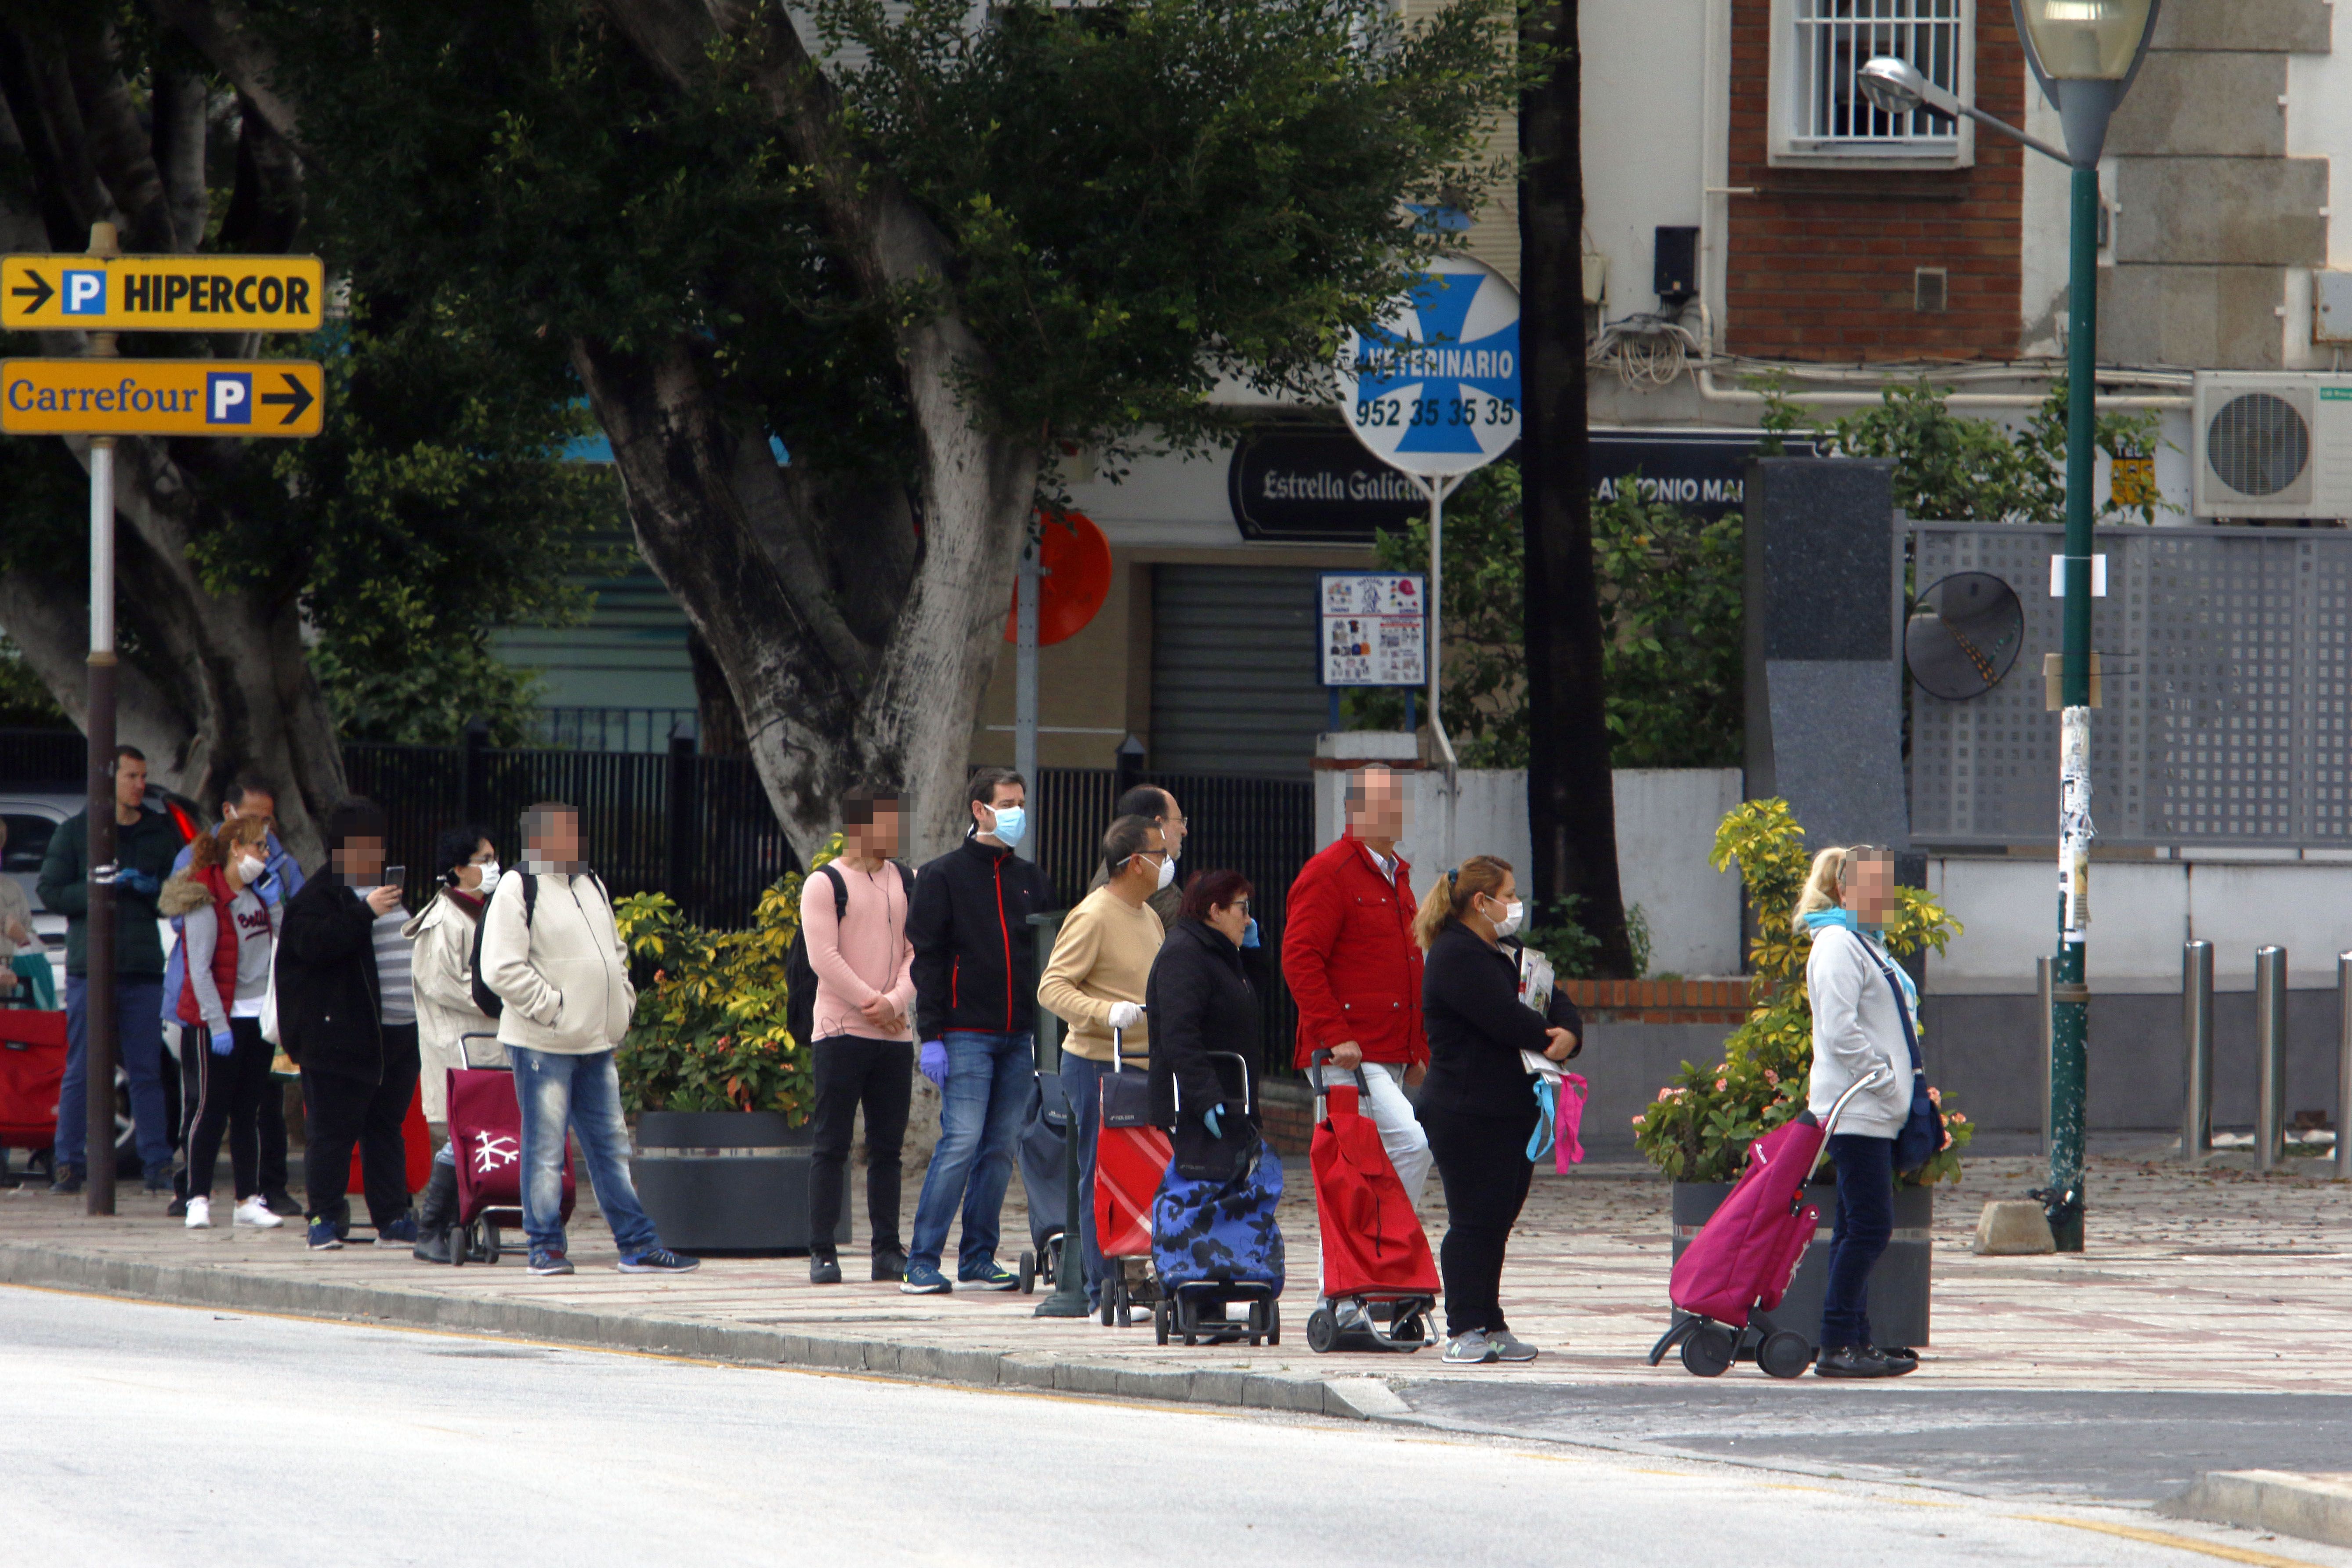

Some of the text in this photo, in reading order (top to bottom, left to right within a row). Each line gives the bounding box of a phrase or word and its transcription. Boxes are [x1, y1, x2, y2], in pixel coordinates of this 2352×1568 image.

[70, 274, 310, 314] P HIPERCOR
[1368, 348, 1514, 379] VETERINARIO
[8, 378, 245, 419] Carrefour P
[1356, 398, 1514, 427] 952 35 35 35
[1262, 470, 1425, 501] Estrella Galicia
